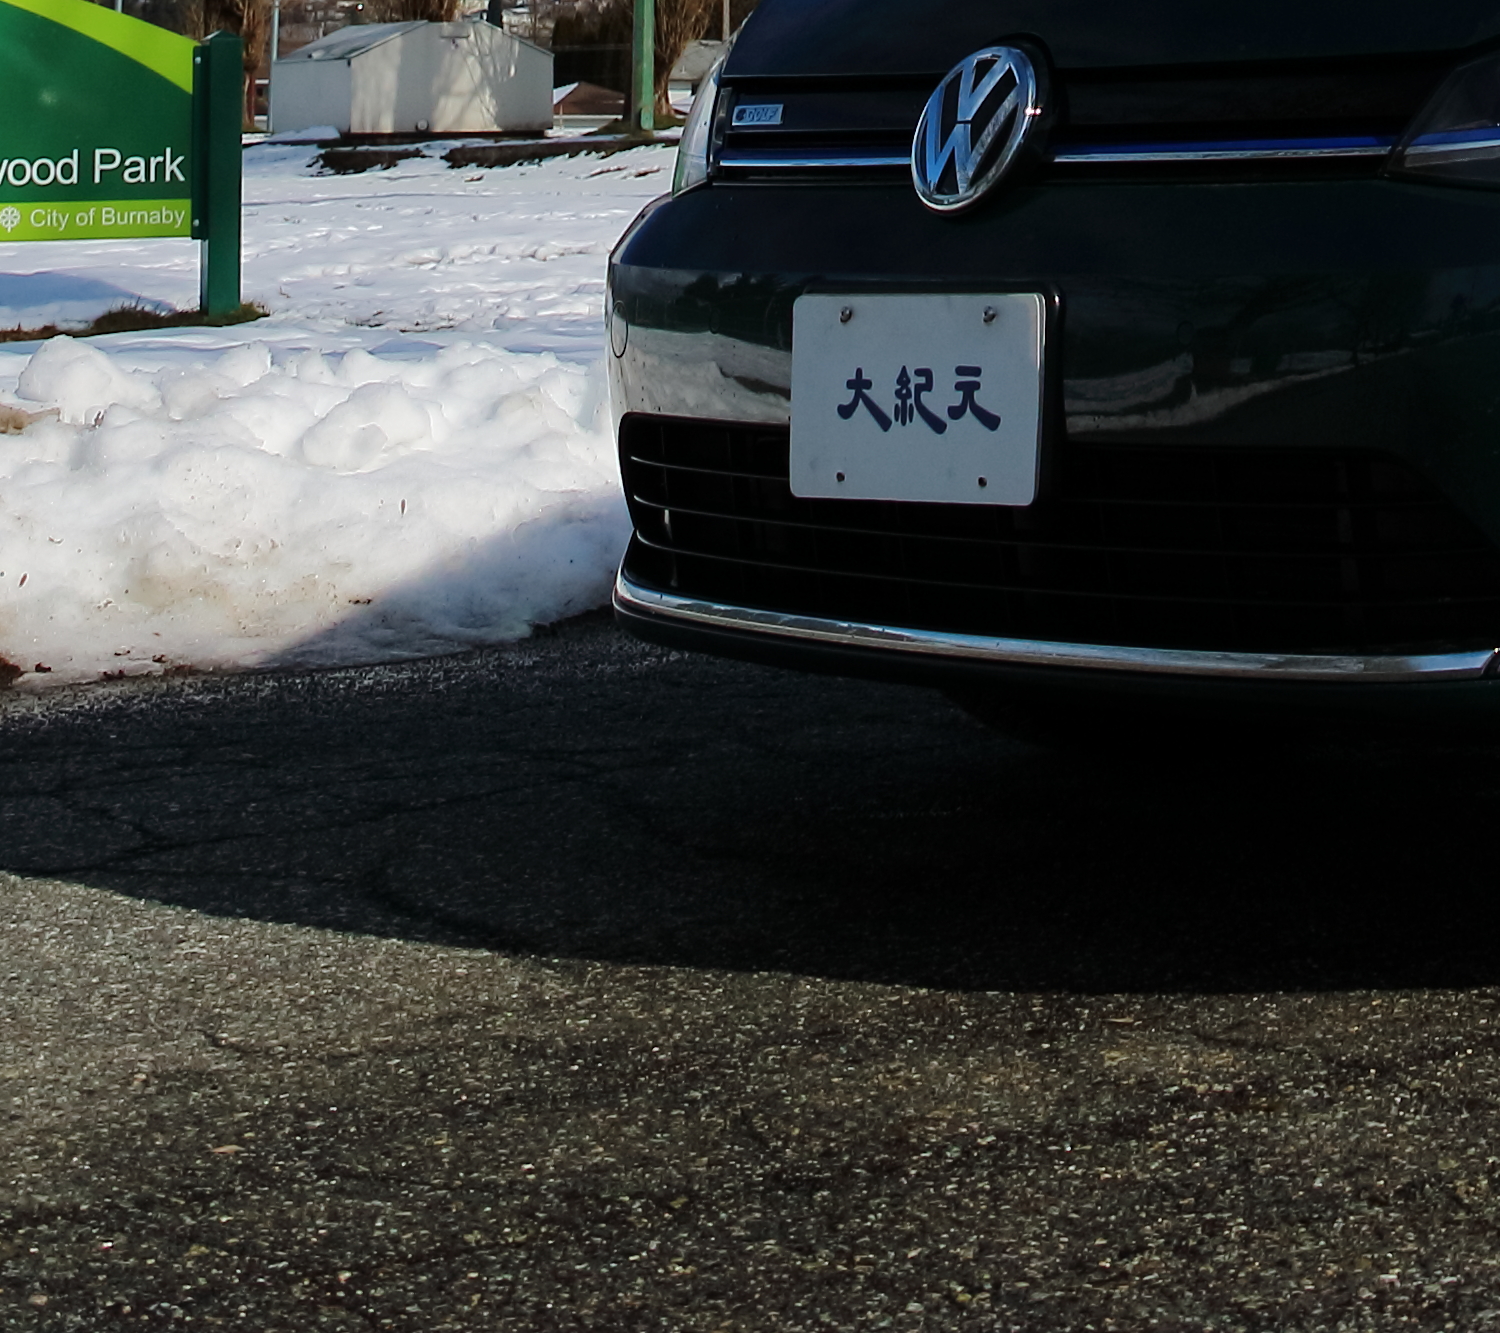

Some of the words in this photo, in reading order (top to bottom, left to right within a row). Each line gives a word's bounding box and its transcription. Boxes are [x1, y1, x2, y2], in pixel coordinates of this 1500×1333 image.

[94, 148, 185, 183] Park
[30, 209, 70, 231] City
[76, 207, 97, 227] of
[102, 203, 186, 229] Burnaby
[837, 365, 1001, 435] 大紀元
